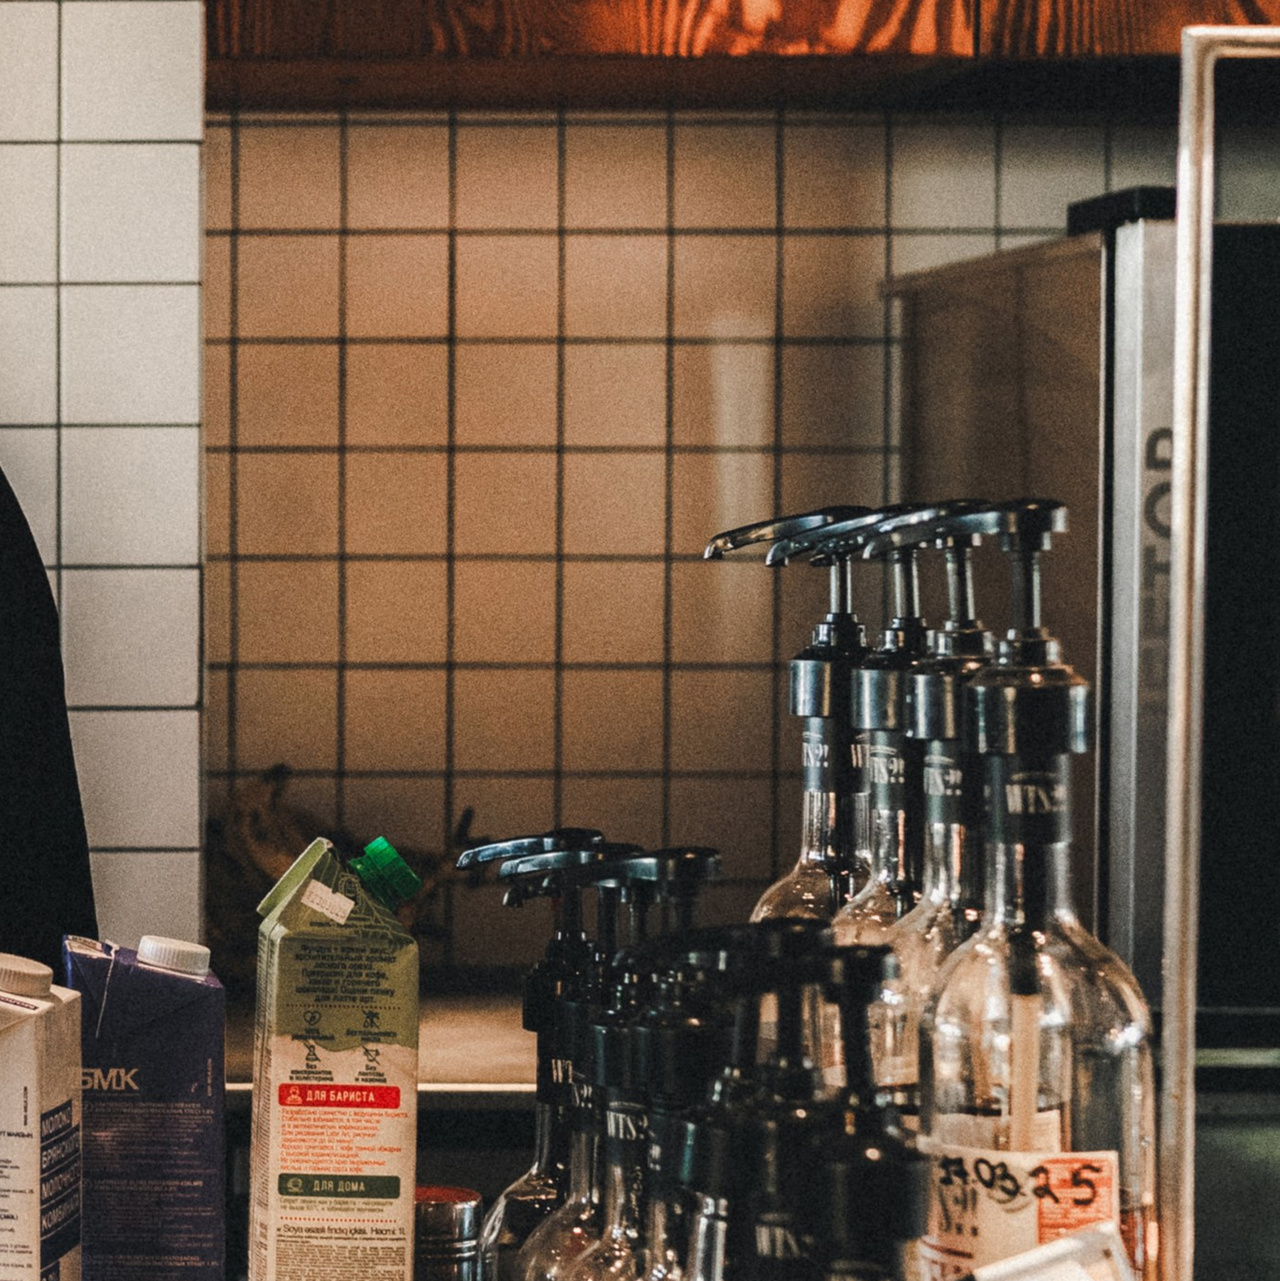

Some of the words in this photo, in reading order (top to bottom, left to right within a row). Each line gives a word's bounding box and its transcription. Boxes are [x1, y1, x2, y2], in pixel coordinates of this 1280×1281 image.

[81, 1067, 140, 1091] БМК
[305, 1090, 327, 1102] ДЛЯ
[329, 1090, 375, 1102] БАРИСТА
[313, 1180, 334, 1192] ДЛЯ
[337, 1181, 366, 1192] ДОМА
[283, 1223, 302, 1235] Soya
